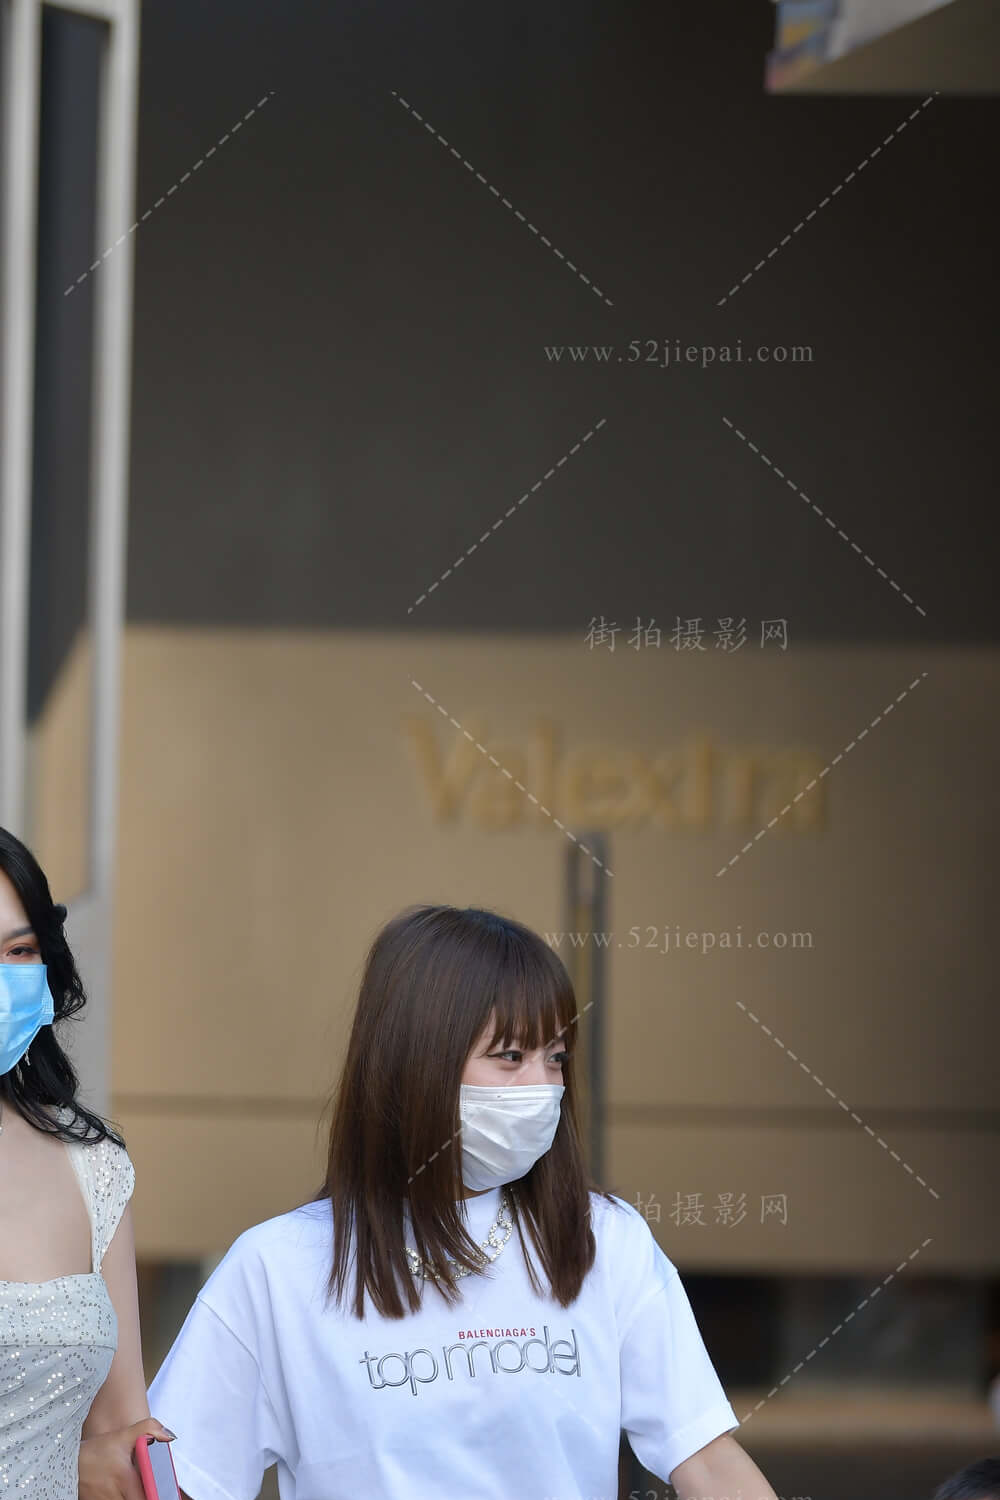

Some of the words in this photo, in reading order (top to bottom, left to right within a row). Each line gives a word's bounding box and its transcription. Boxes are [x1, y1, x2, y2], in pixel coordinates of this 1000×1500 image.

[458, 1327, 536, 1340] BALENCIAGA'S
[359, 1348, 439, 1396] top
[442, 1325, 581, 1380] model
